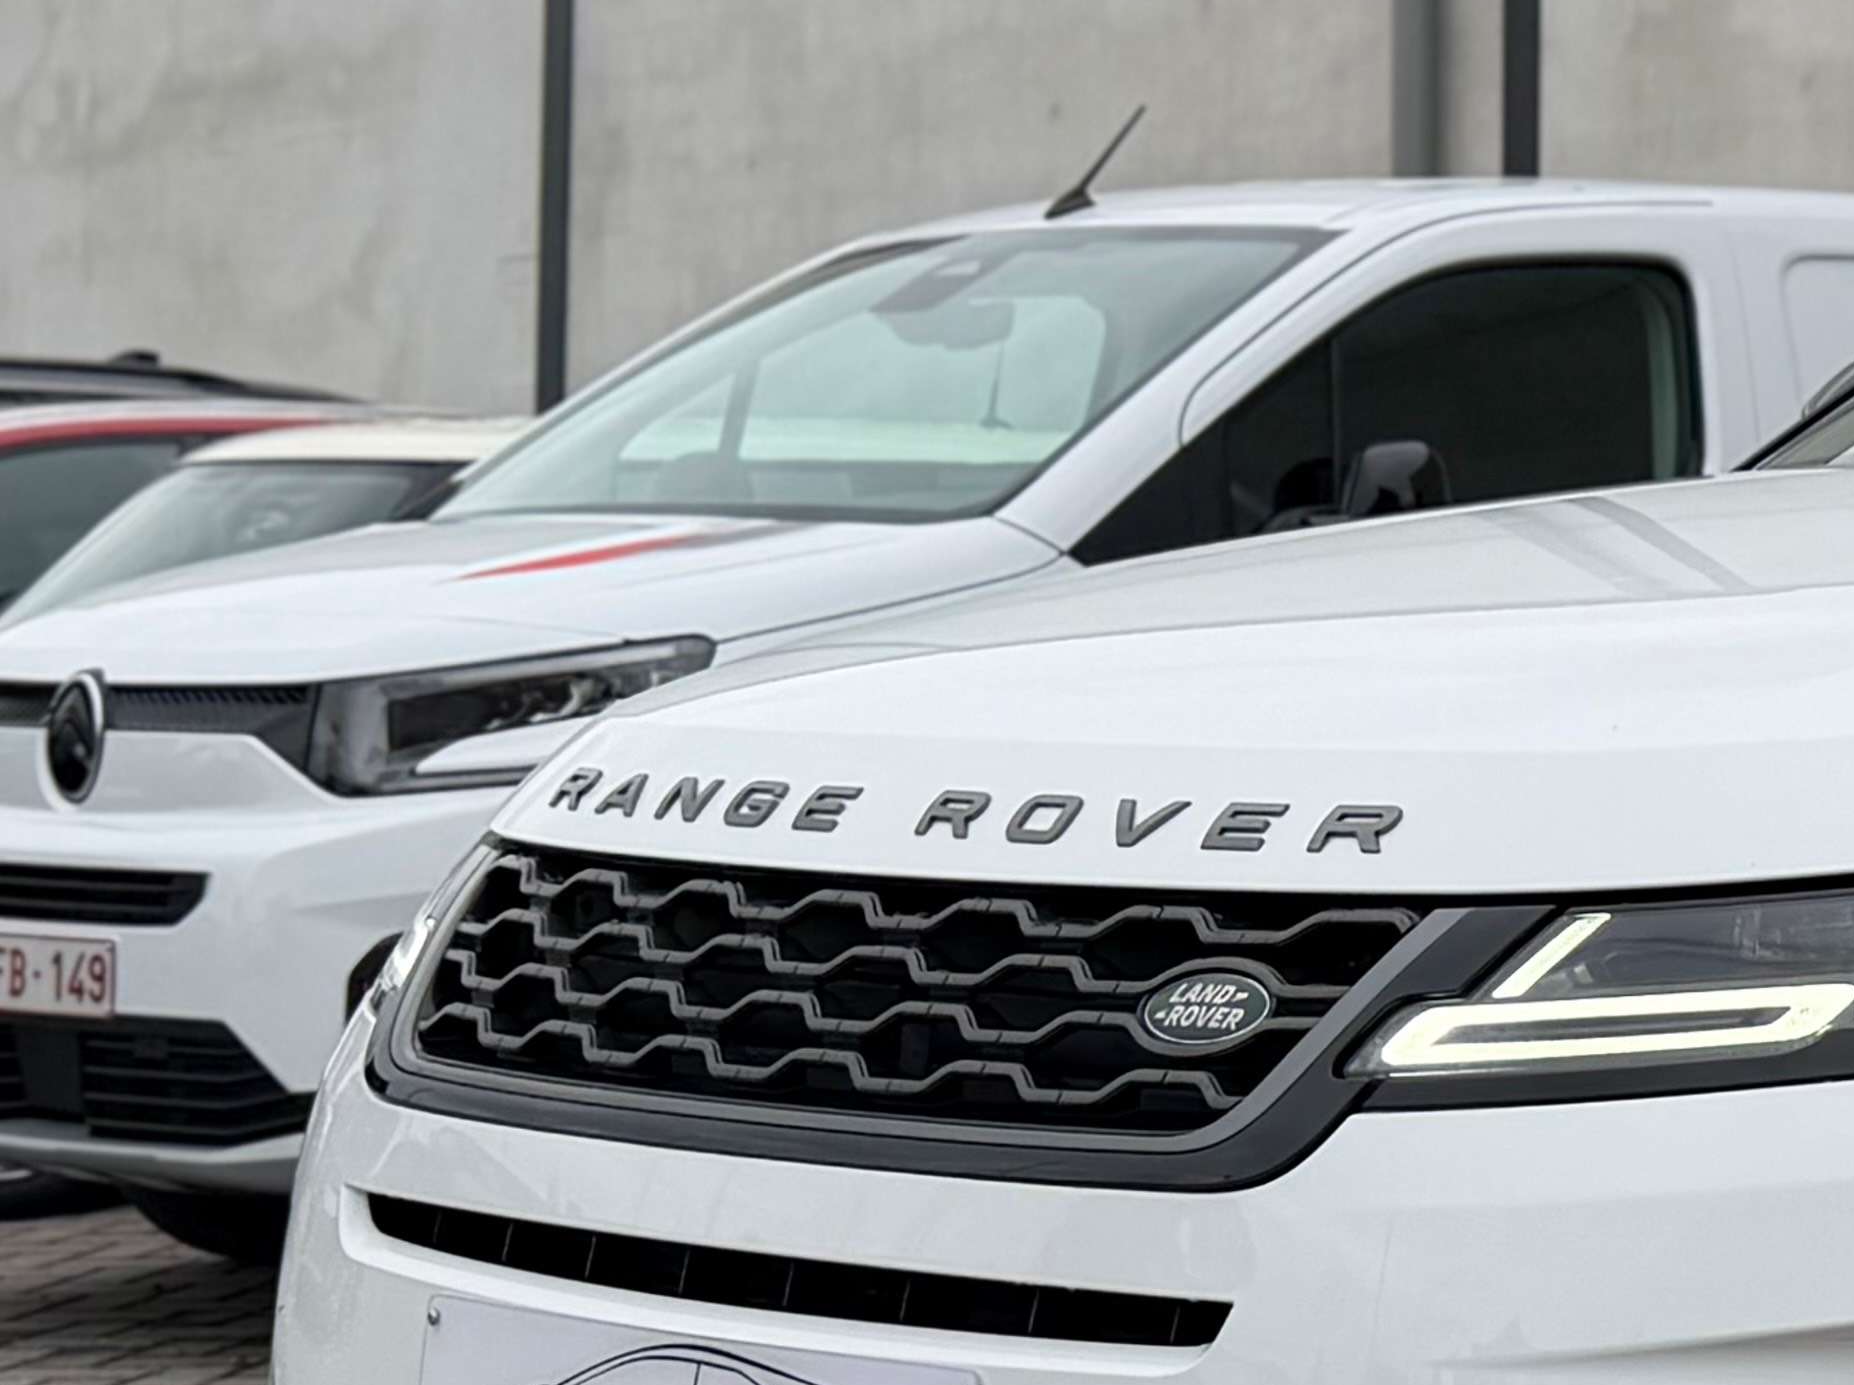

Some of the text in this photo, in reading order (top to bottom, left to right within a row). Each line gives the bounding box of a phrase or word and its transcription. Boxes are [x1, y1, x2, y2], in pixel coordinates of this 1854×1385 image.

[549, 767, 1404, 854] RANGE ROVER
[1163, 1005, 1244, 1030] ROVER
